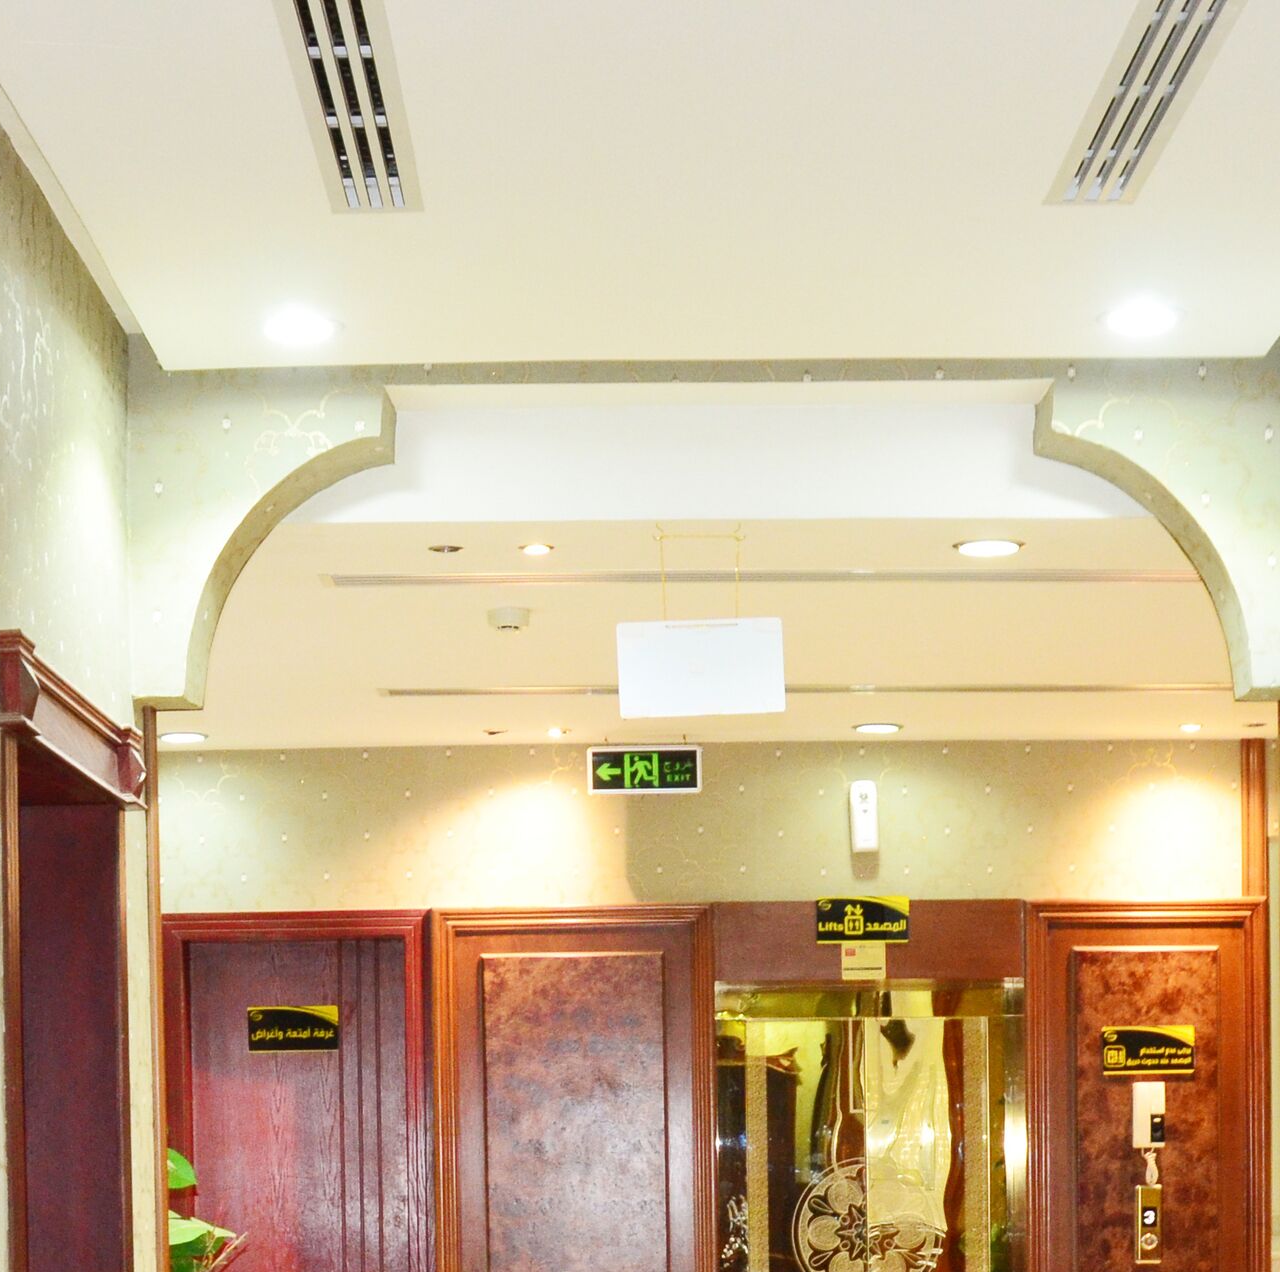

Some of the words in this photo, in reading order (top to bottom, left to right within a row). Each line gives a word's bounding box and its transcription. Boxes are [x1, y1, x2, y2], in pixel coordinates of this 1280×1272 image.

[666, 774, 691, 782] EXIT
[818, 922, 844, 932] Lifts
[865, 919, 907, 932] المصعد
[313, 1027, 335, 1040] غرفة
[1143, 1210, 1155, 1224] 3
